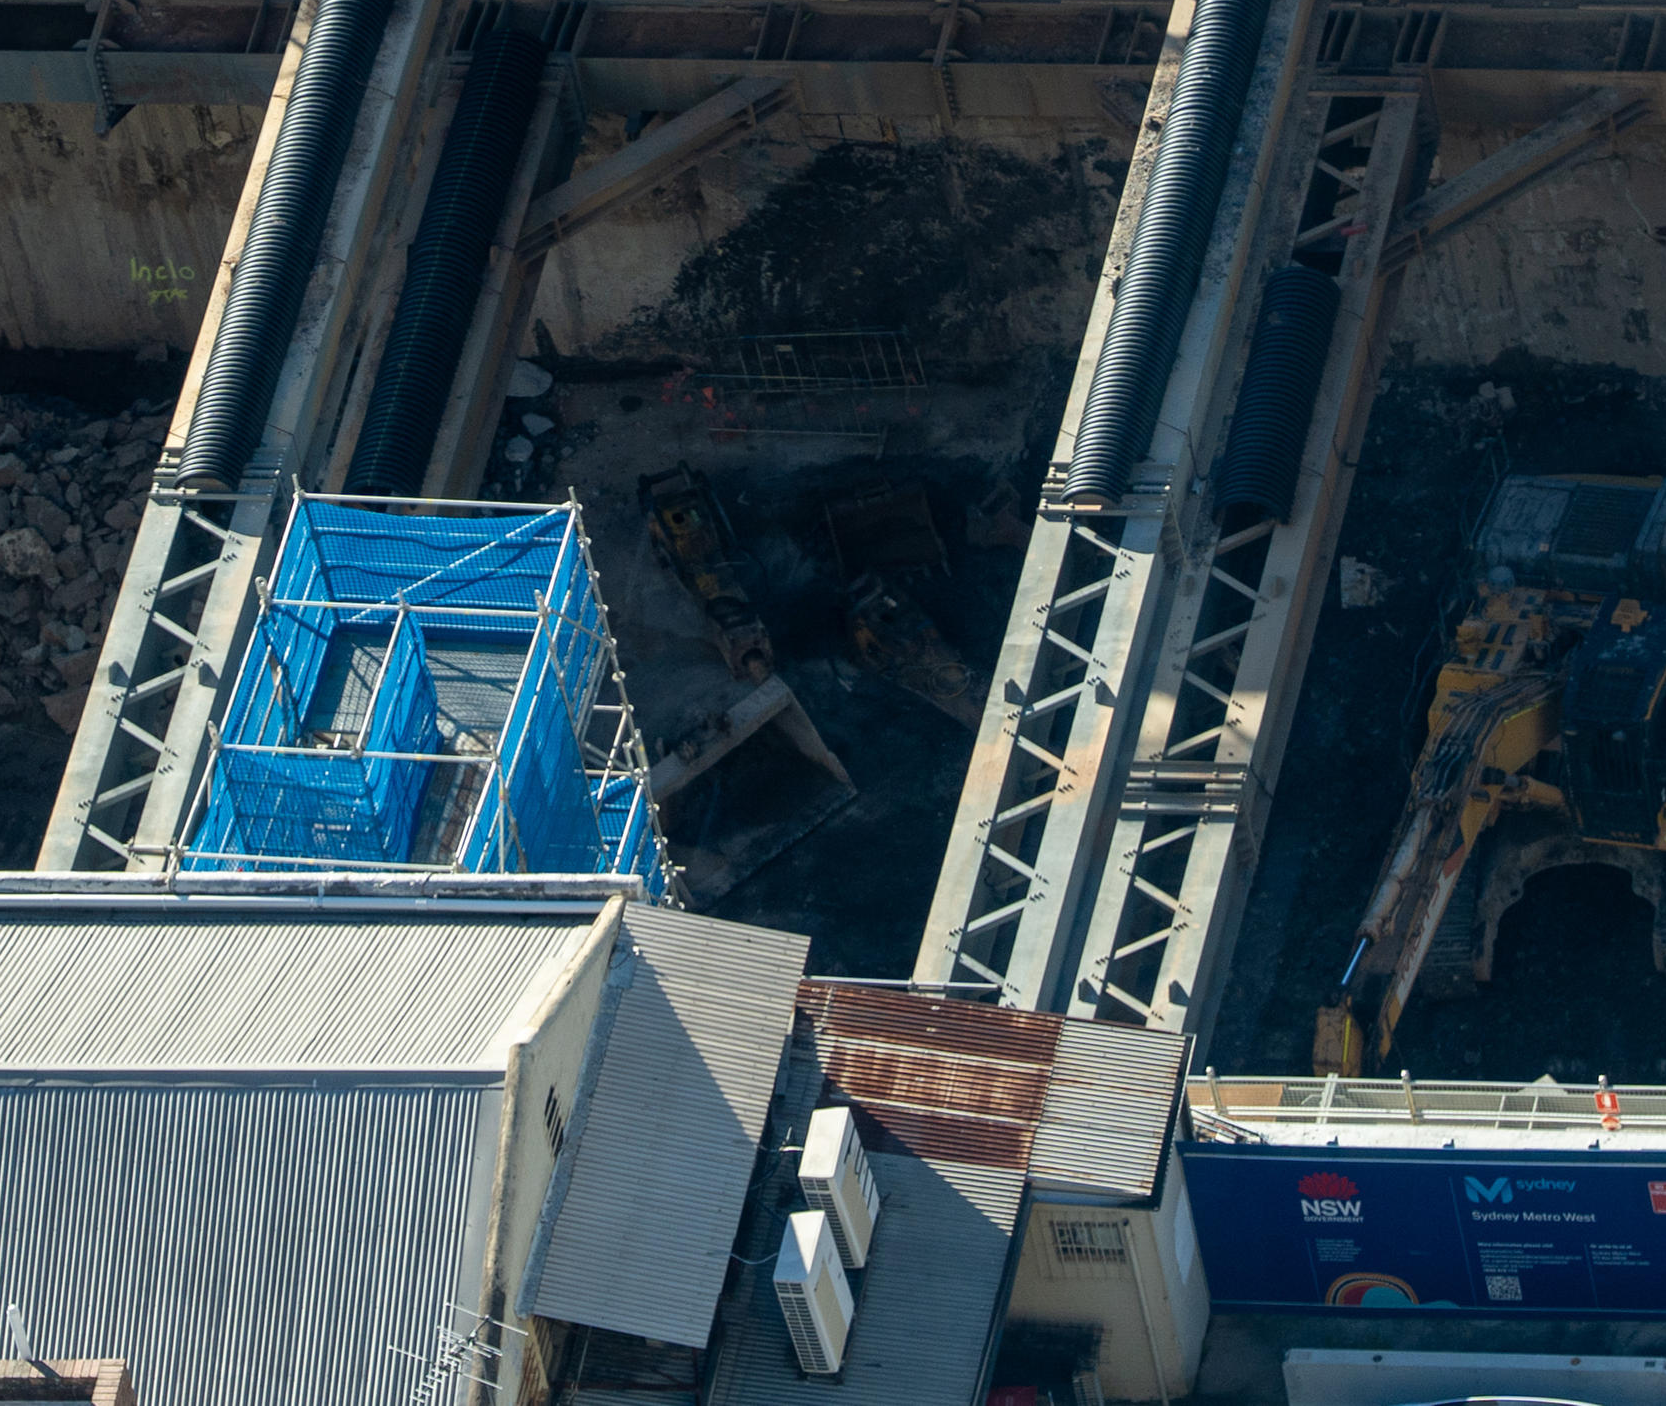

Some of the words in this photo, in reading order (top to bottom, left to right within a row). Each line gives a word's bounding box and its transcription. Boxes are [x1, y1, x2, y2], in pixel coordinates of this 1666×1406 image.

[1516, 1177, 1577, 1193] sydney
[1300, 1199, 1361, 1217] NSW
[1303, 1216, 1364, 1224] GOVERNMENT
[1472, 1210, 1520, 1223] Sydney
[1522, 1212, 1561, 1222] Metro
[1562, 1212, 1596, 1223] West
